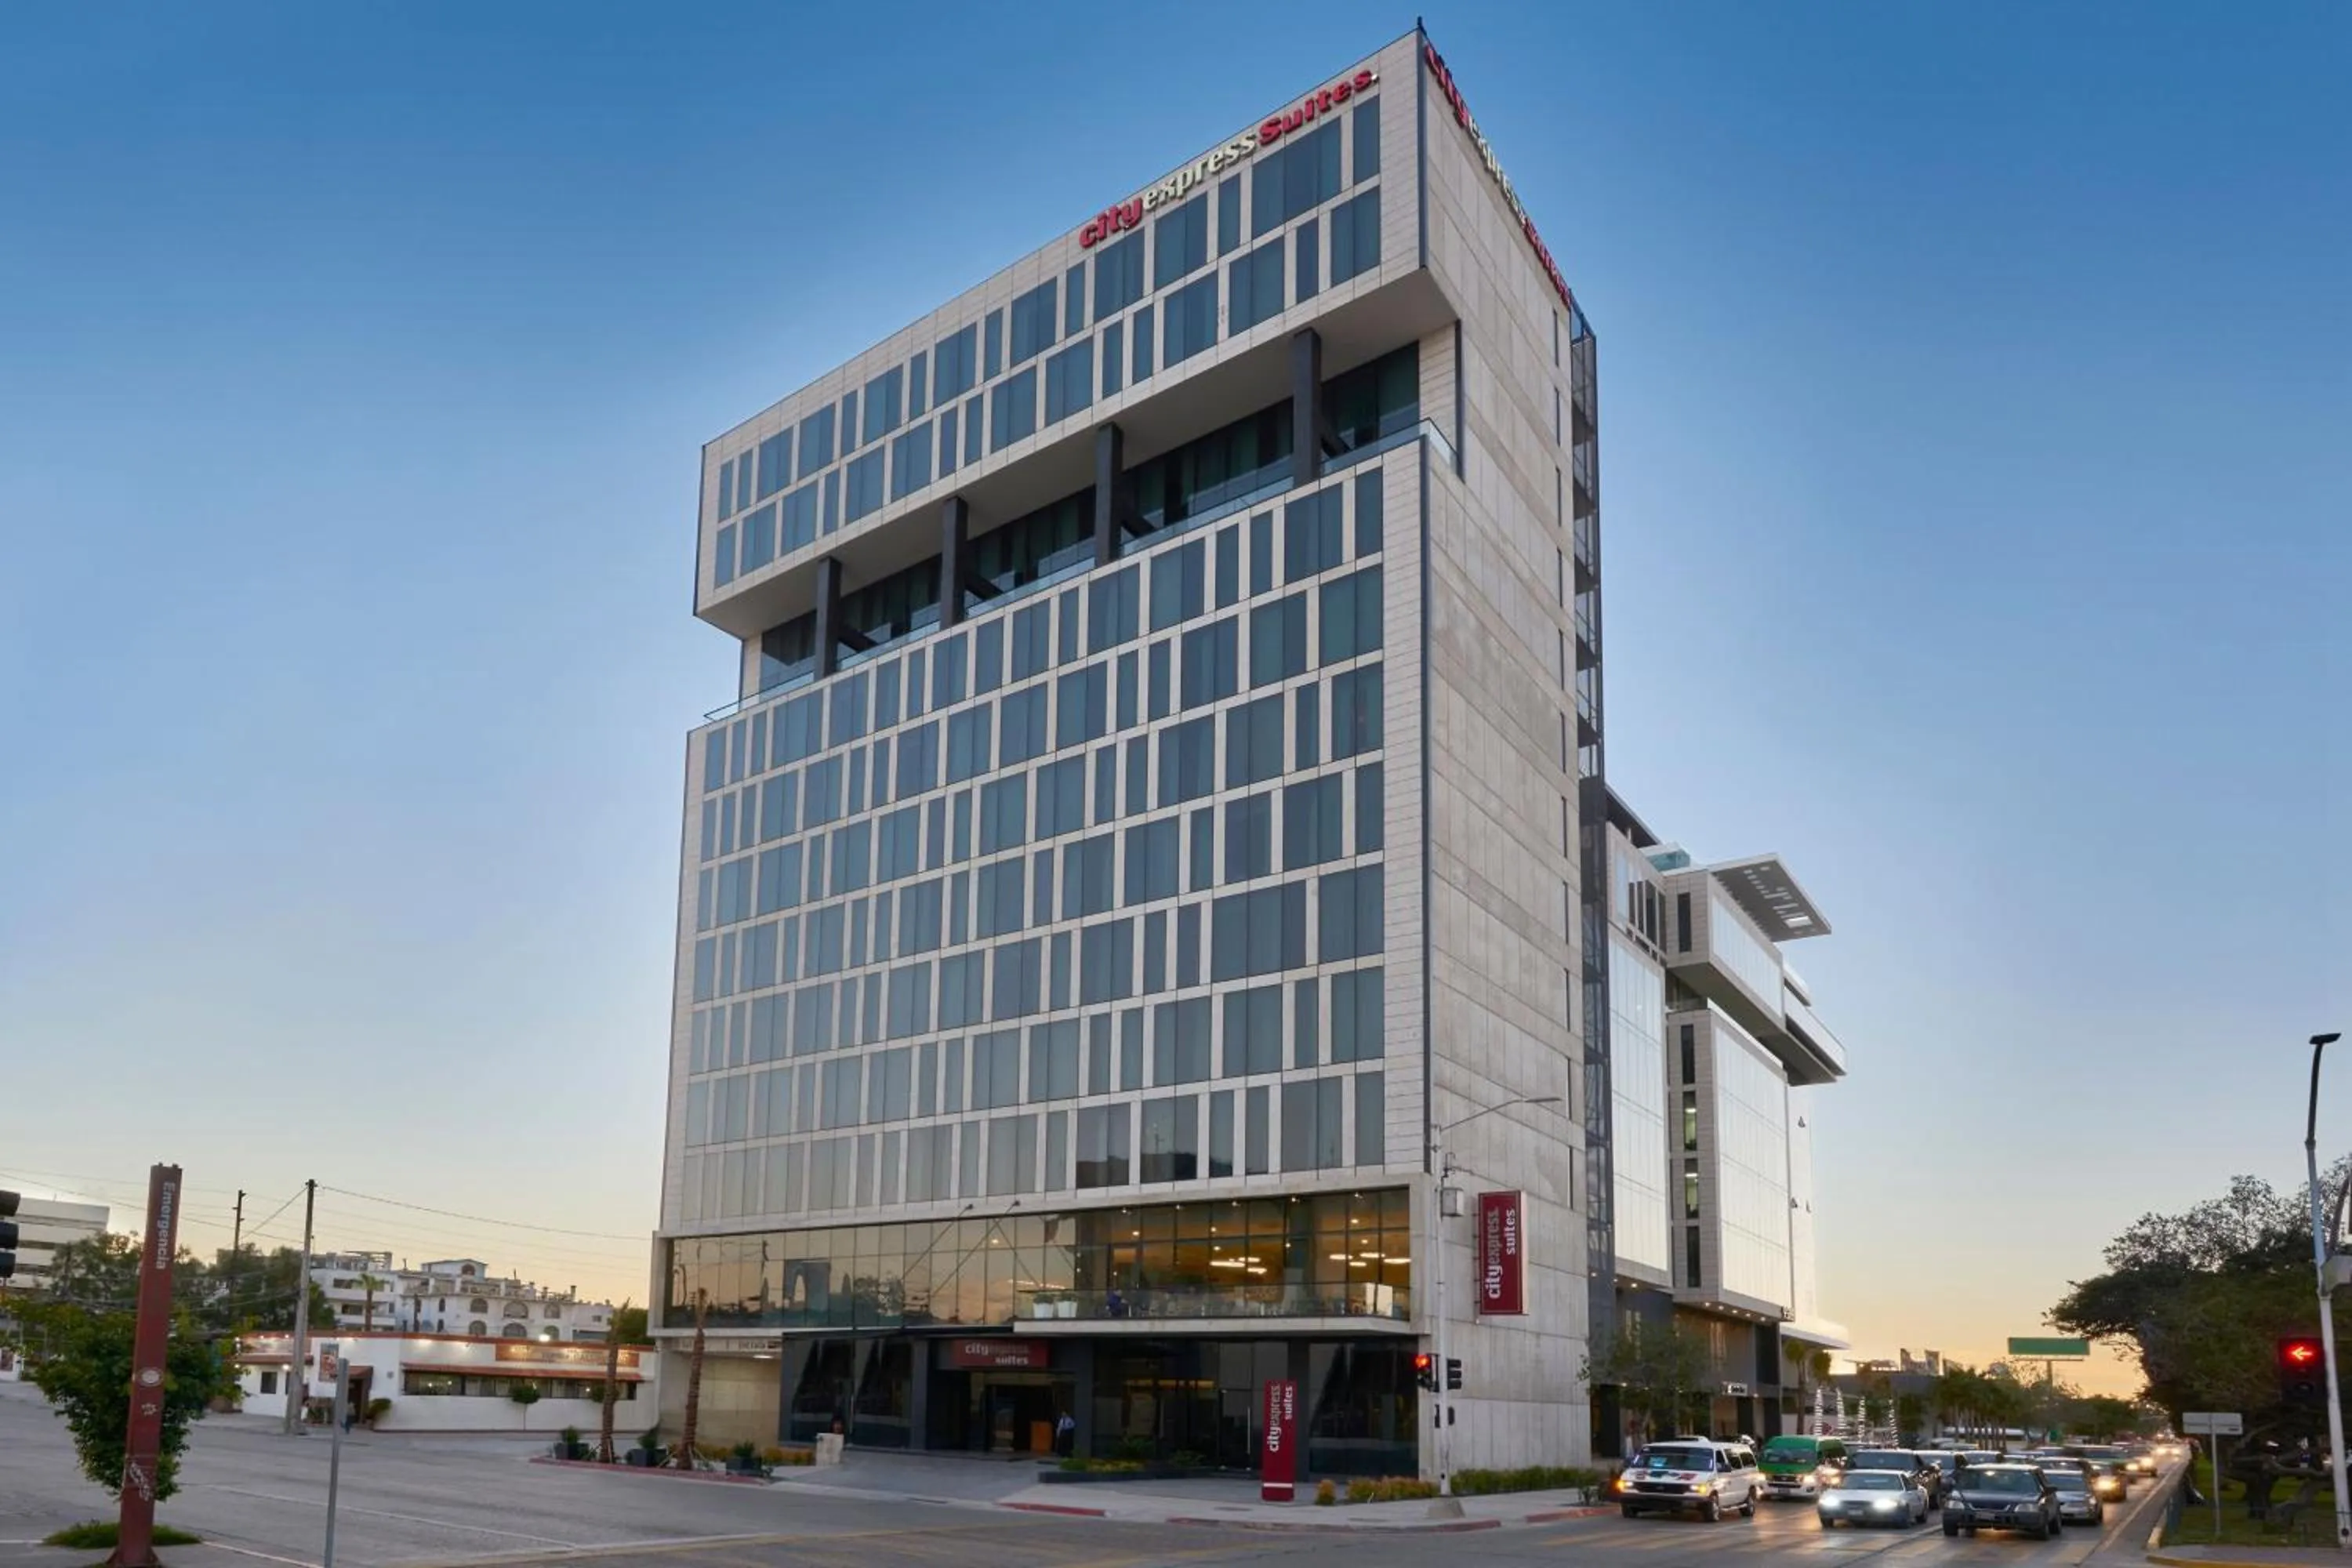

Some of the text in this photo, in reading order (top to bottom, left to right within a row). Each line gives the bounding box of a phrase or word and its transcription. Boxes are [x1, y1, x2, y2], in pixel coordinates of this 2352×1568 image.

[155, 1181, 176, 1269] Emergencia
[1504, 1209, 1515, 1255] suites
[1283, 1386, 1293, 1421] suites
